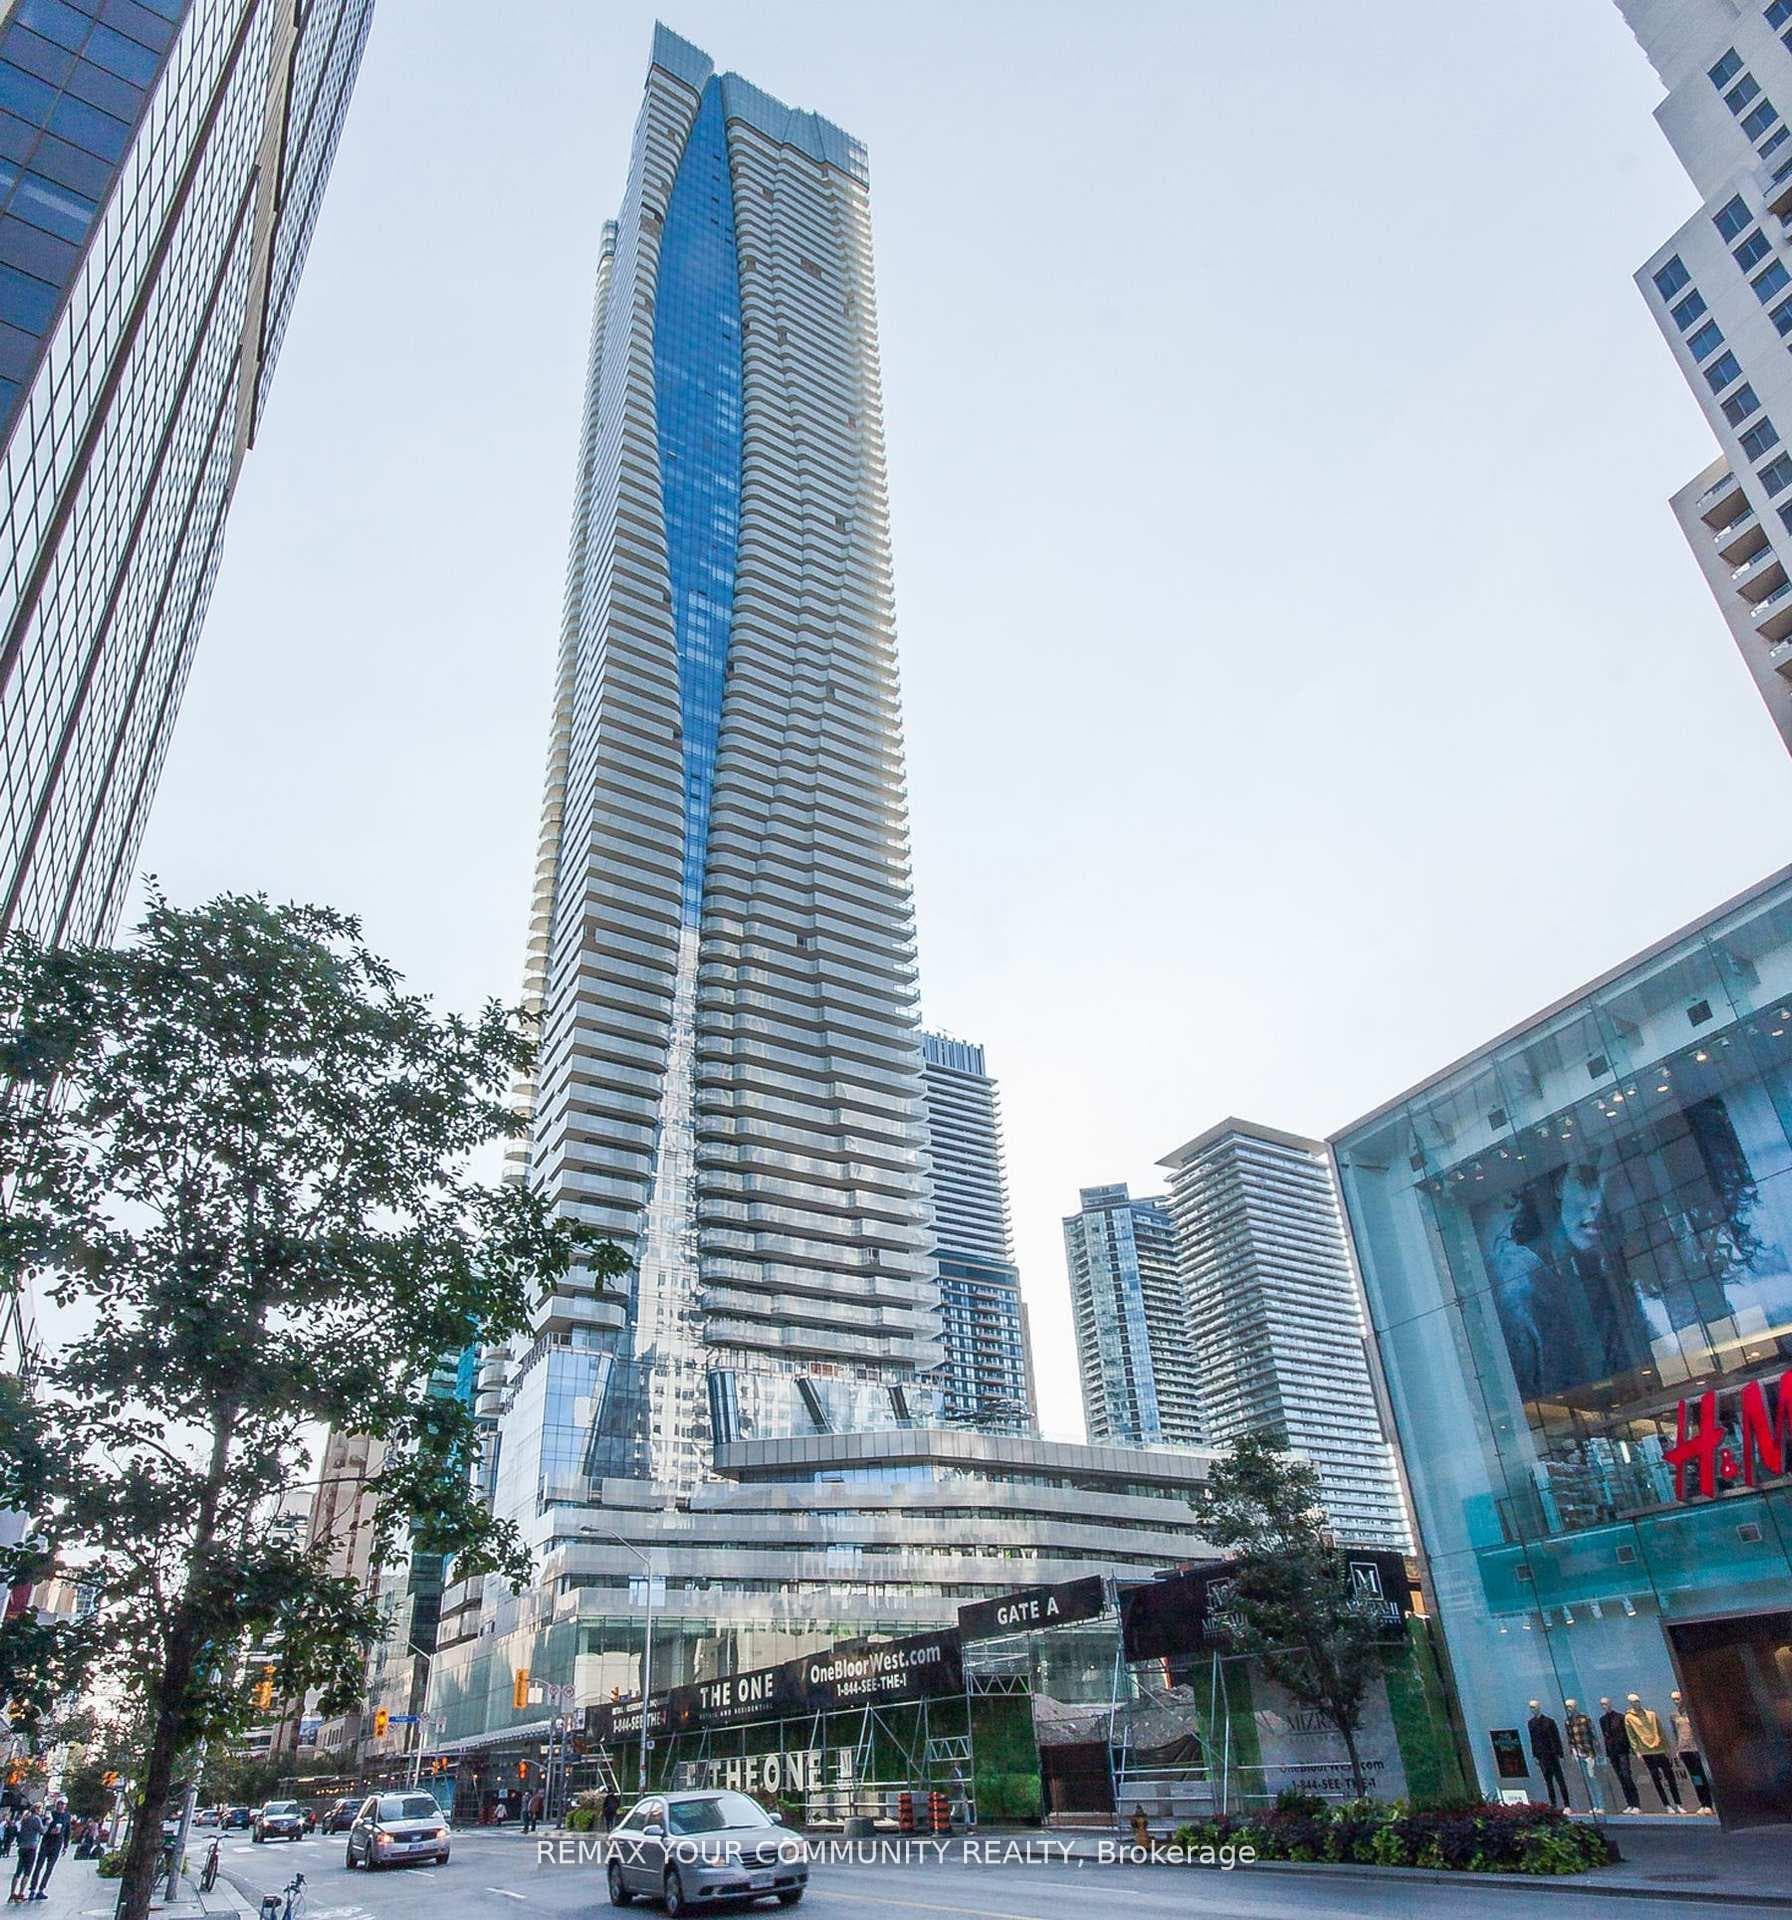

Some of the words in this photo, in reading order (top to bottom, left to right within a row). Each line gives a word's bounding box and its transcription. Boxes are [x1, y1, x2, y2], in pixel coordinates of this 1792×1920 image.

[997, 1600, 1040, 1625] GATE
[1047, 1596, 1060, 1616] A
[810, 1645, 941, 1684] OneBloorWest.com
[700, 1681, 732, 1709] THE
[738, 1672, 773, 1702] ONE
[837, 1672, 907, 1697] 1-844-SEE-THE-1
[1292, 1777, 1376, 1791] 1-844-SEE-TE-1
